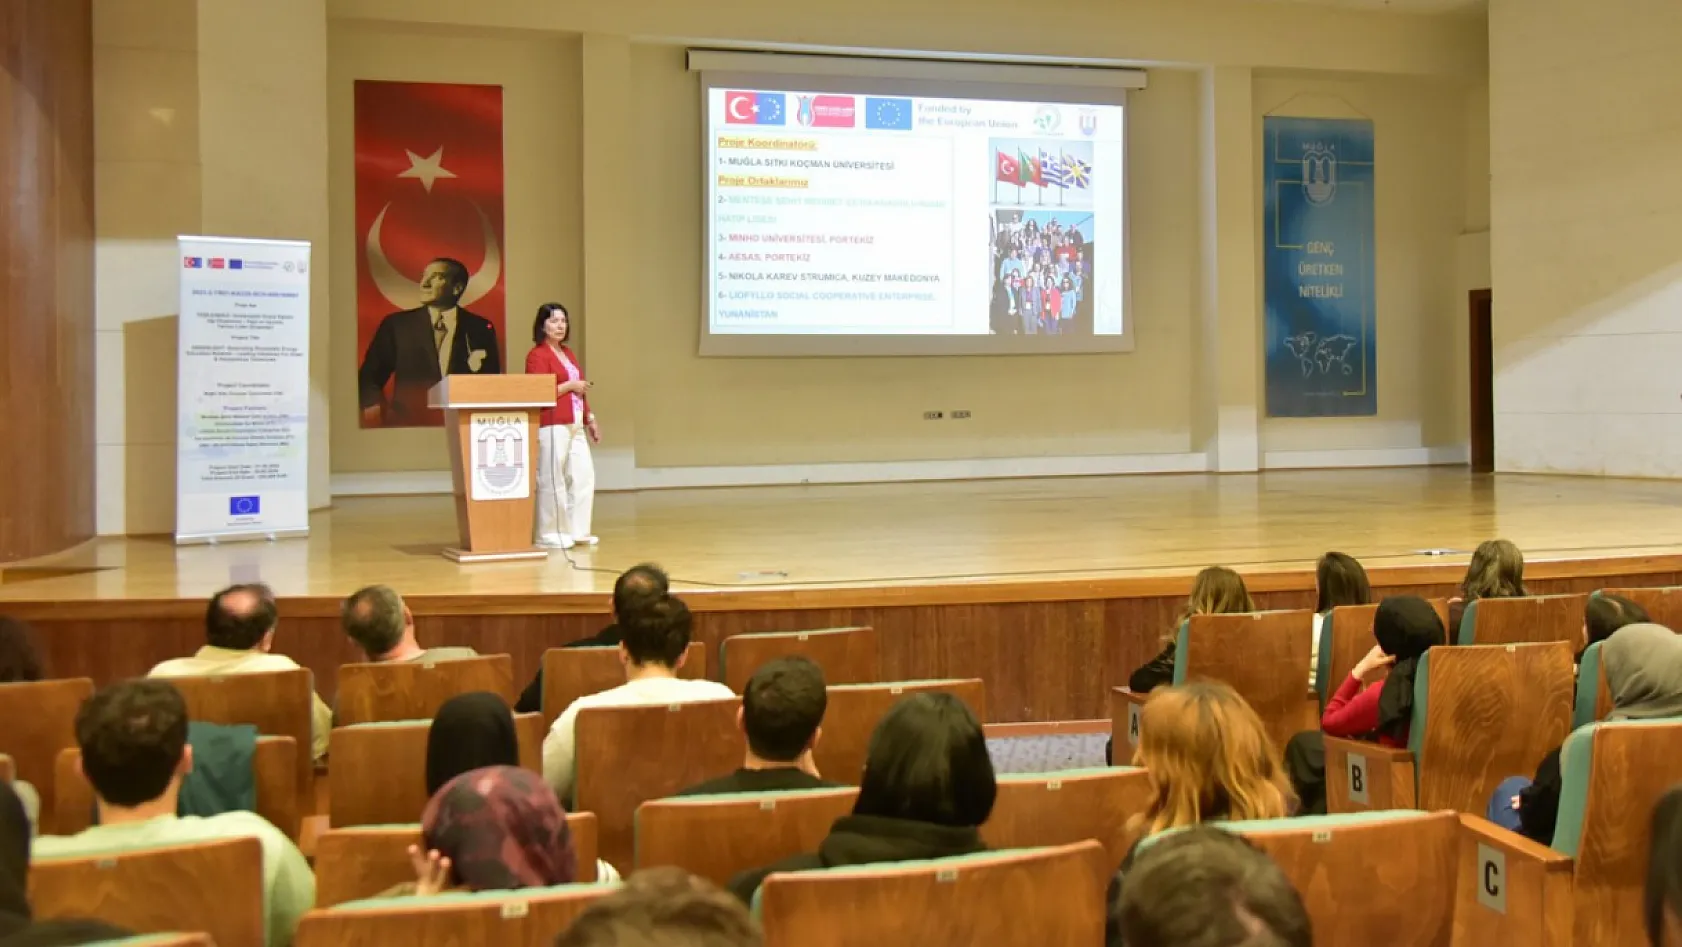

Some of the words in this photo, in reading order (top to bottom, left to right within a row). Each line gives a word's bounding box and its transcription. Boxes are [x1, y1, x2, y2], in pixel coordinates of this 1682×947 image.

[728, 156, 762, 166] MUĞLA
[789, 159, 831, 169] KOÇMAN
[1306, 241, 1334, 256] GENÇ
[1298, 262, 1343, 276] ÜRETKEN
[766, 273, 798, 281] KAREV
[851, 273, 881, 283] KUZEY
[884, 274, 940, 283] MAKEDONYA
[1298, 283, 1343, 298] NİTELİKLİ
[477, 416, 521, 425] MUĞLA
[1131, 712, 1139, 736] A
[1351, 764, 1363, 791] B
[1485, 860, 1499, 896] C
